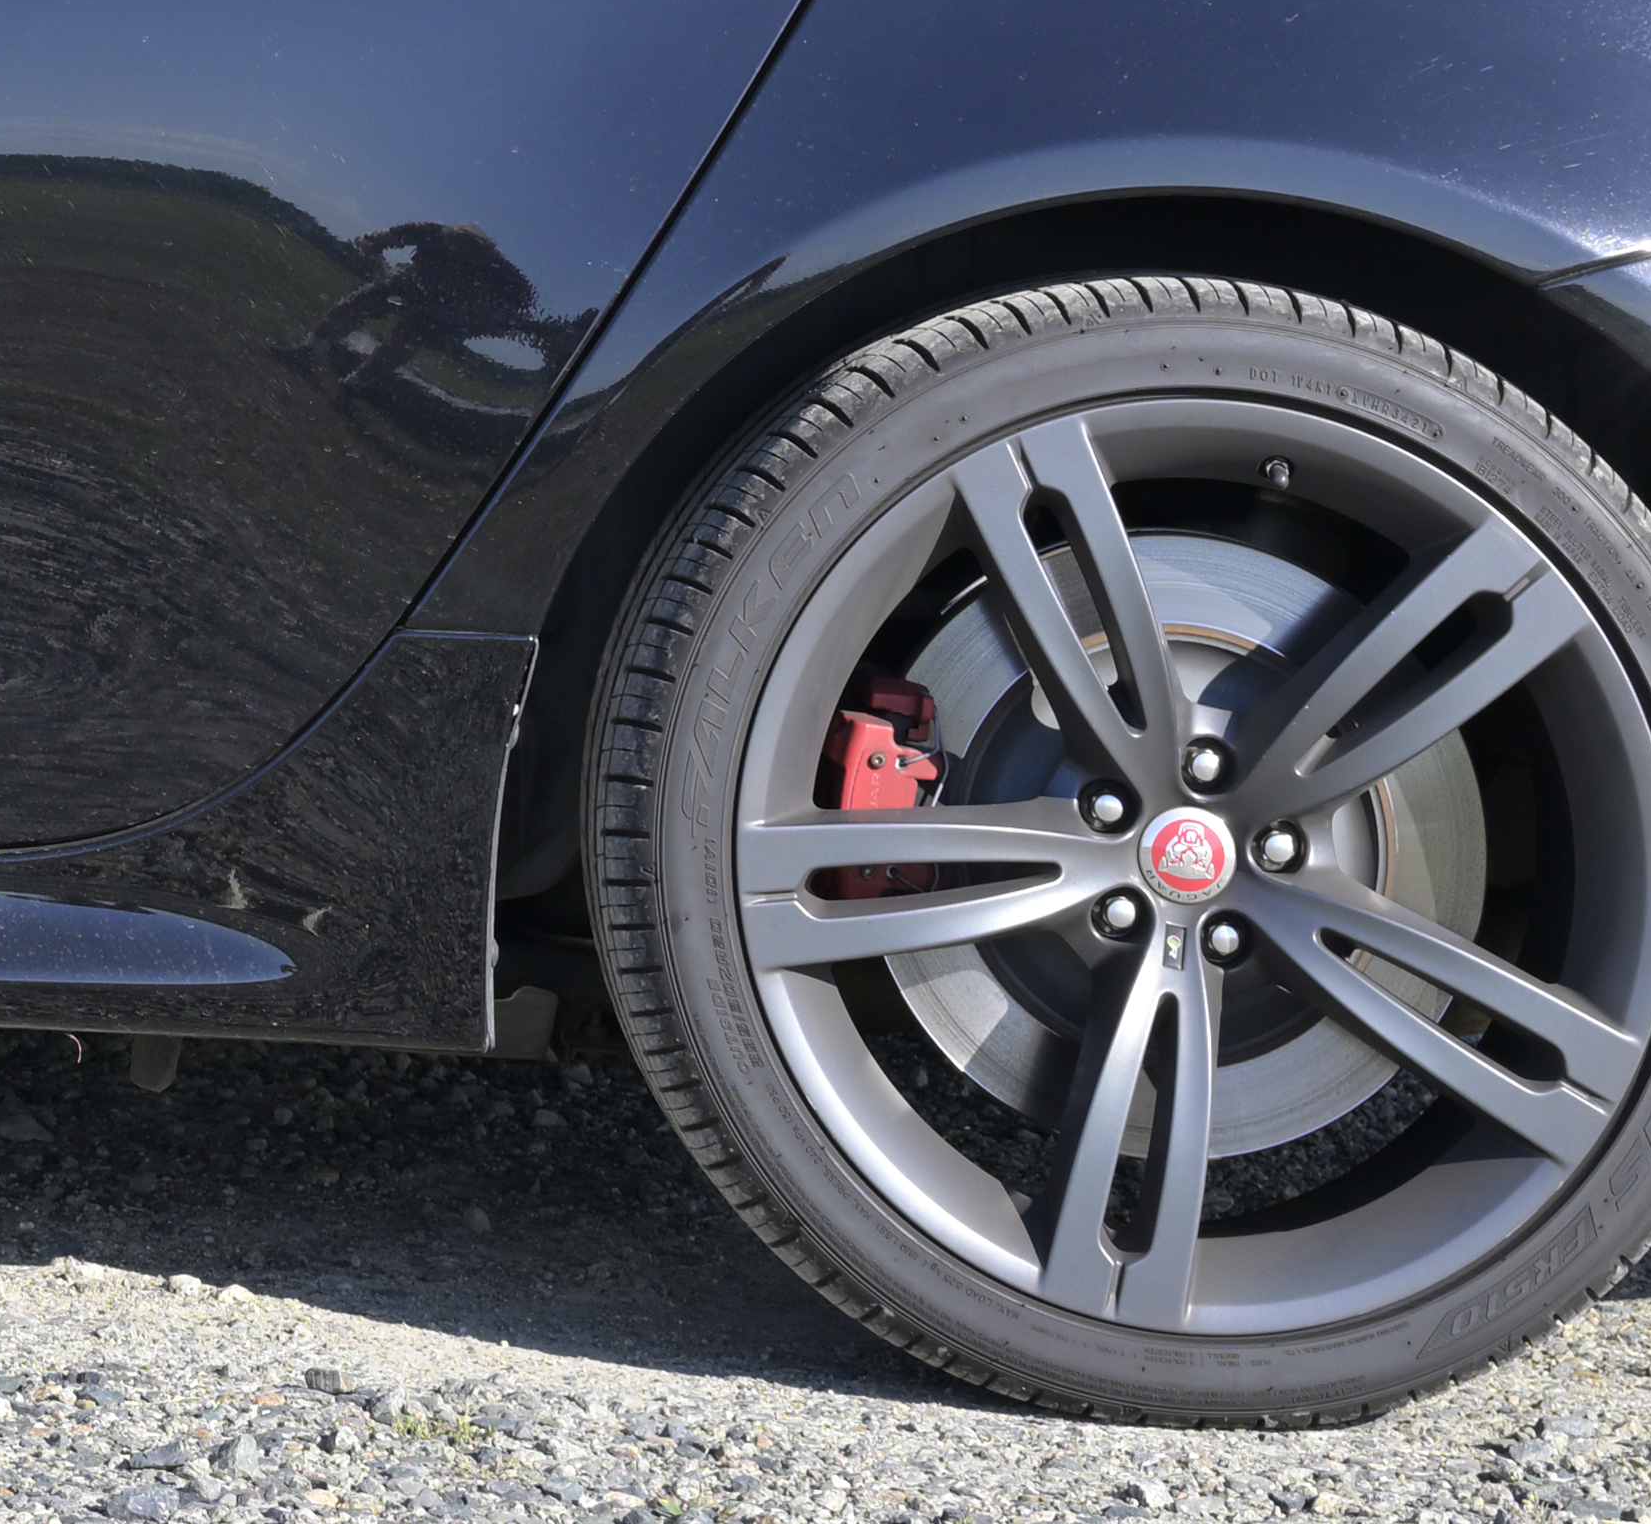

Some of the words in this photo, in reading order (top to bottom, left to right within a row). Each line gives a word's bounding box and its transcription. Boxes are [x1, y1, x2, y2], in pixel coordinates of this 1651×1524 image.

[1248, 366, 1280, 384] DOT
[1489, 435, 1547, 483] TREADWEAR
[1611, 604, 1634, 634] LOAD
[672, 470, 868, 838] FALKEN
[1145, 869, 1222, 901] JAGUAR
[705, 975, 751, 1078] OUTSIDE
[819, 1163, 852, 1200] PRESS.
[963, 1285, 993, 1307] LOAD
[1442, 1217, 1594, 1339] FK510
